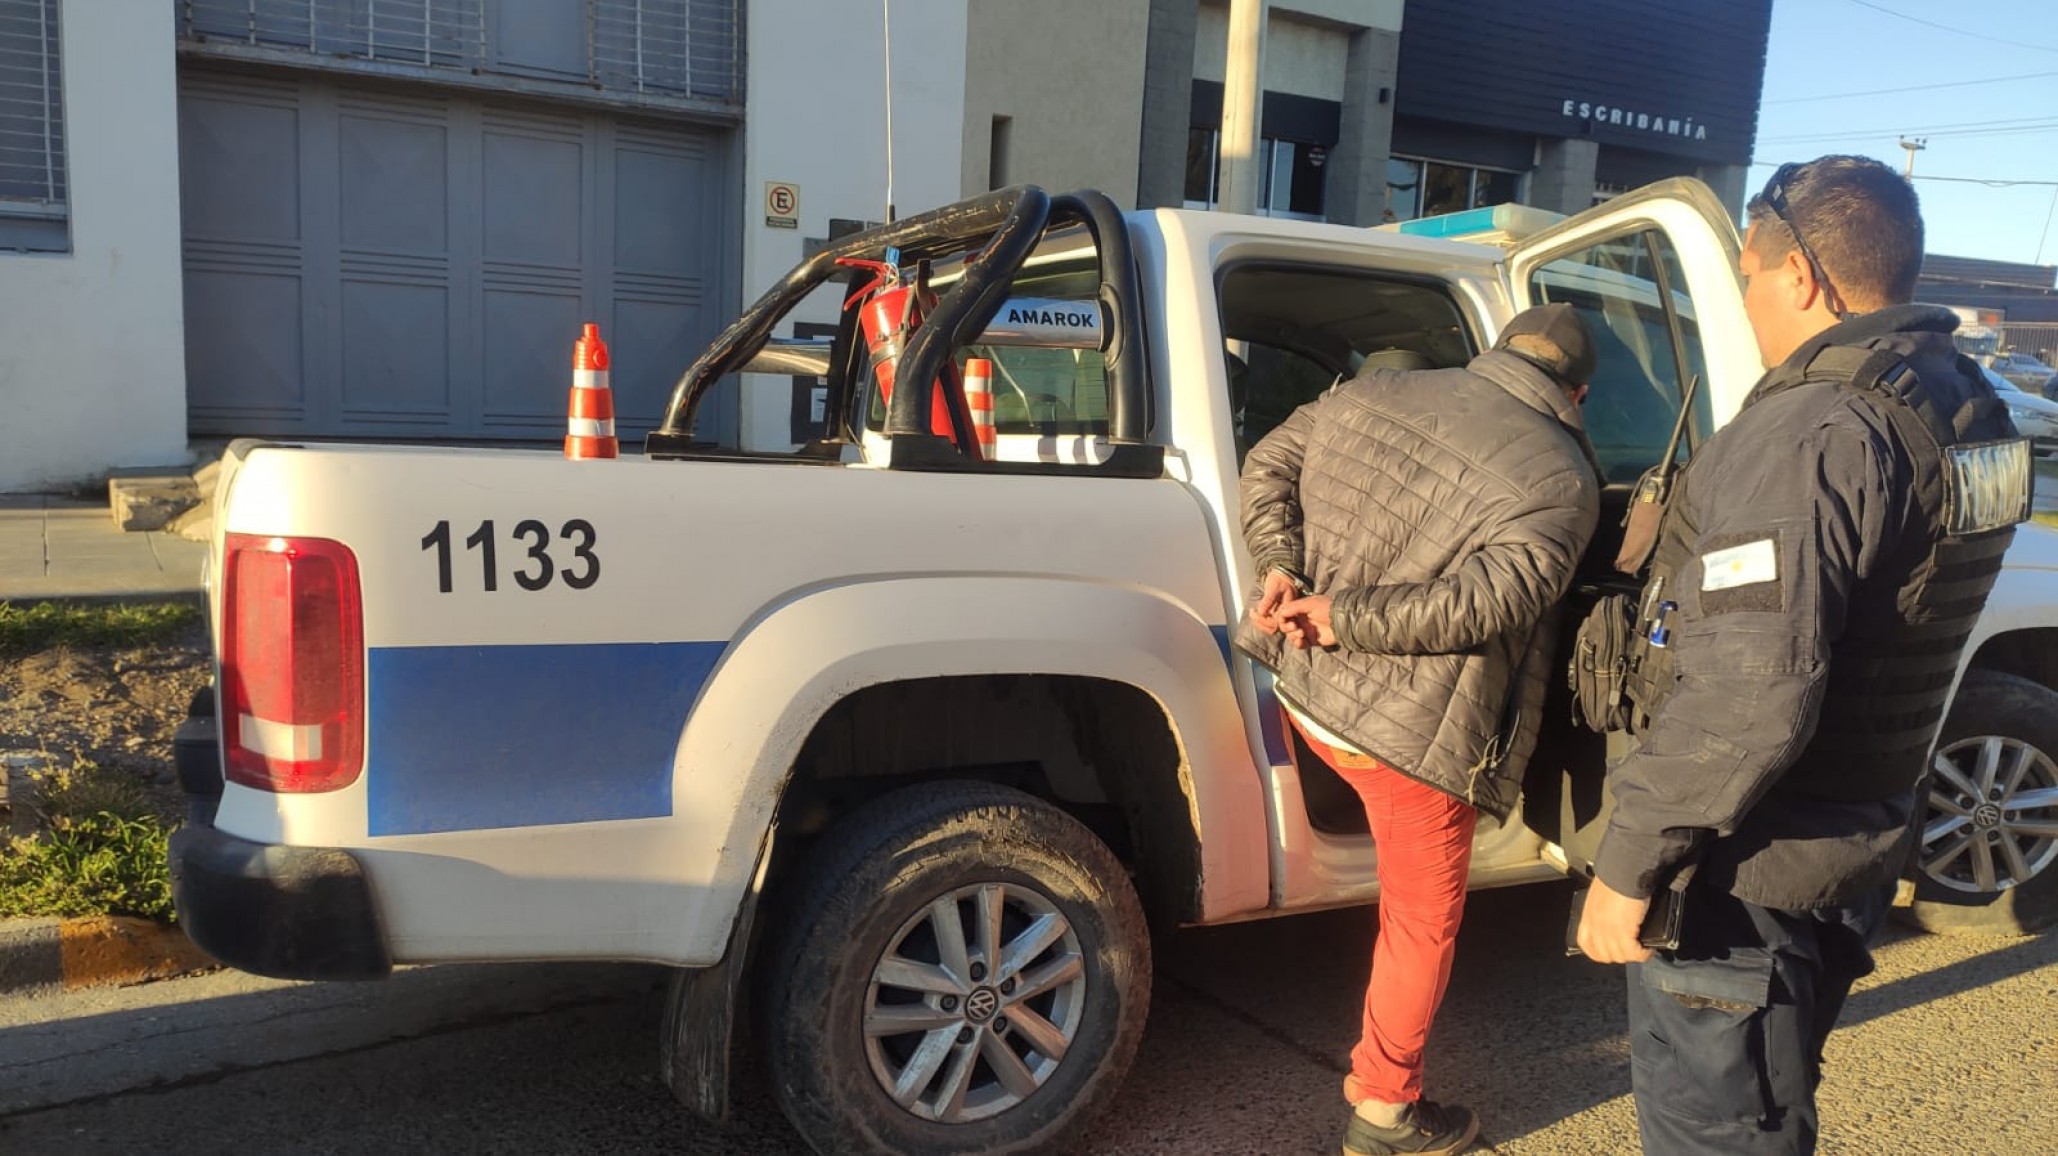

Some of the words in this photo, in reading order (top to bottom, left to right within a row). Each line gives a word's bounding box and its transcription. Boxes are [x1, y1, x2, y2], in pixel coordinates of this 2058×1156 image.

[1563, 100, 1706, 140] ESCRIBANÍA
[776, 192, 788, 208] E
[1008, 308, 1094, 328] AMAROK
[421, 518, 600, 593] 1133
